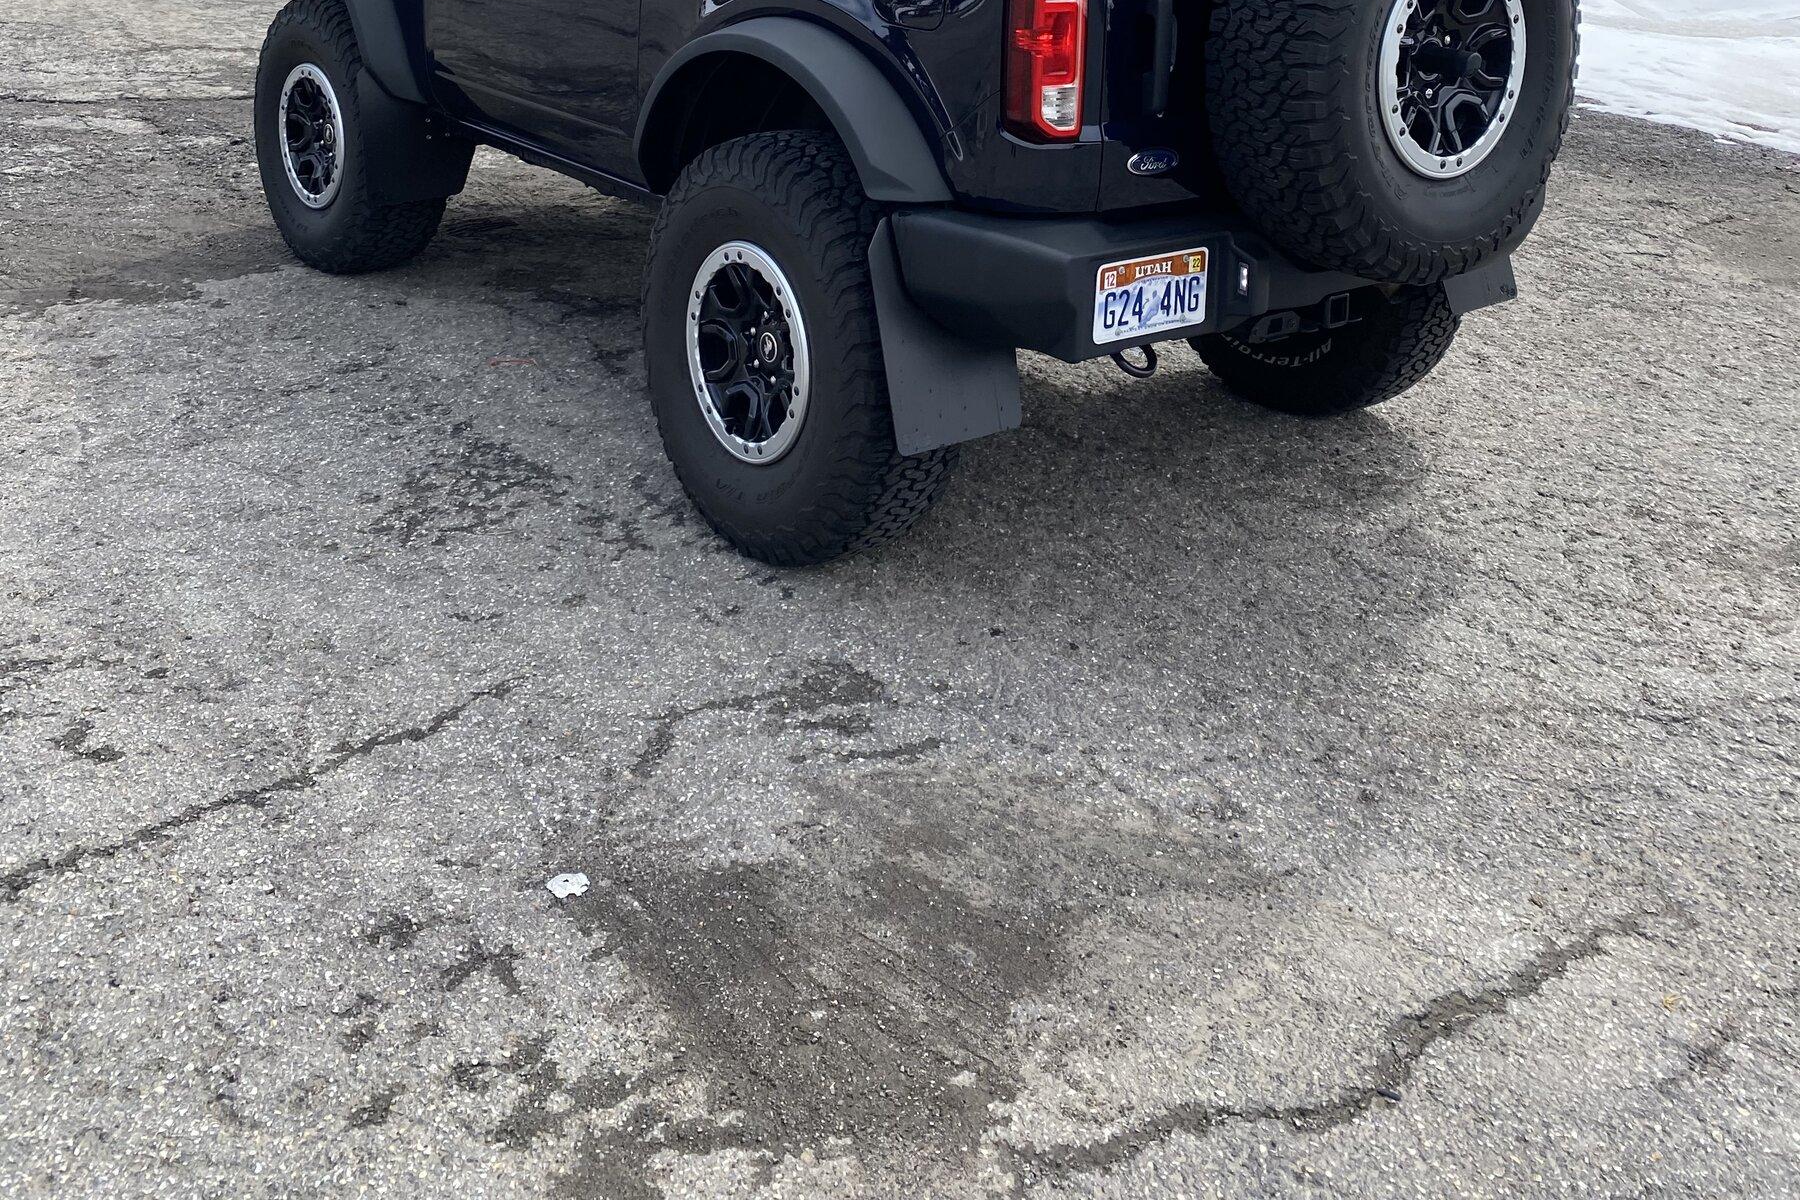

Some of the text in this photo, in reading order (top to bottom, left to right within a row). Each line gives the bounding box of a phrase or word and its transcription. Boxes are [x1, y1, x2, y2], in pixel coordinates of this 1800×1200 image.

[1140, 156, 1168, 171] Ford
[1134, 260, 1173, 279] UTAH
[1192, 257, 1201, 269] 22
[1106, 273, 1116, 287] 12
[1103, 276, 1200, 330] G24 4NG
